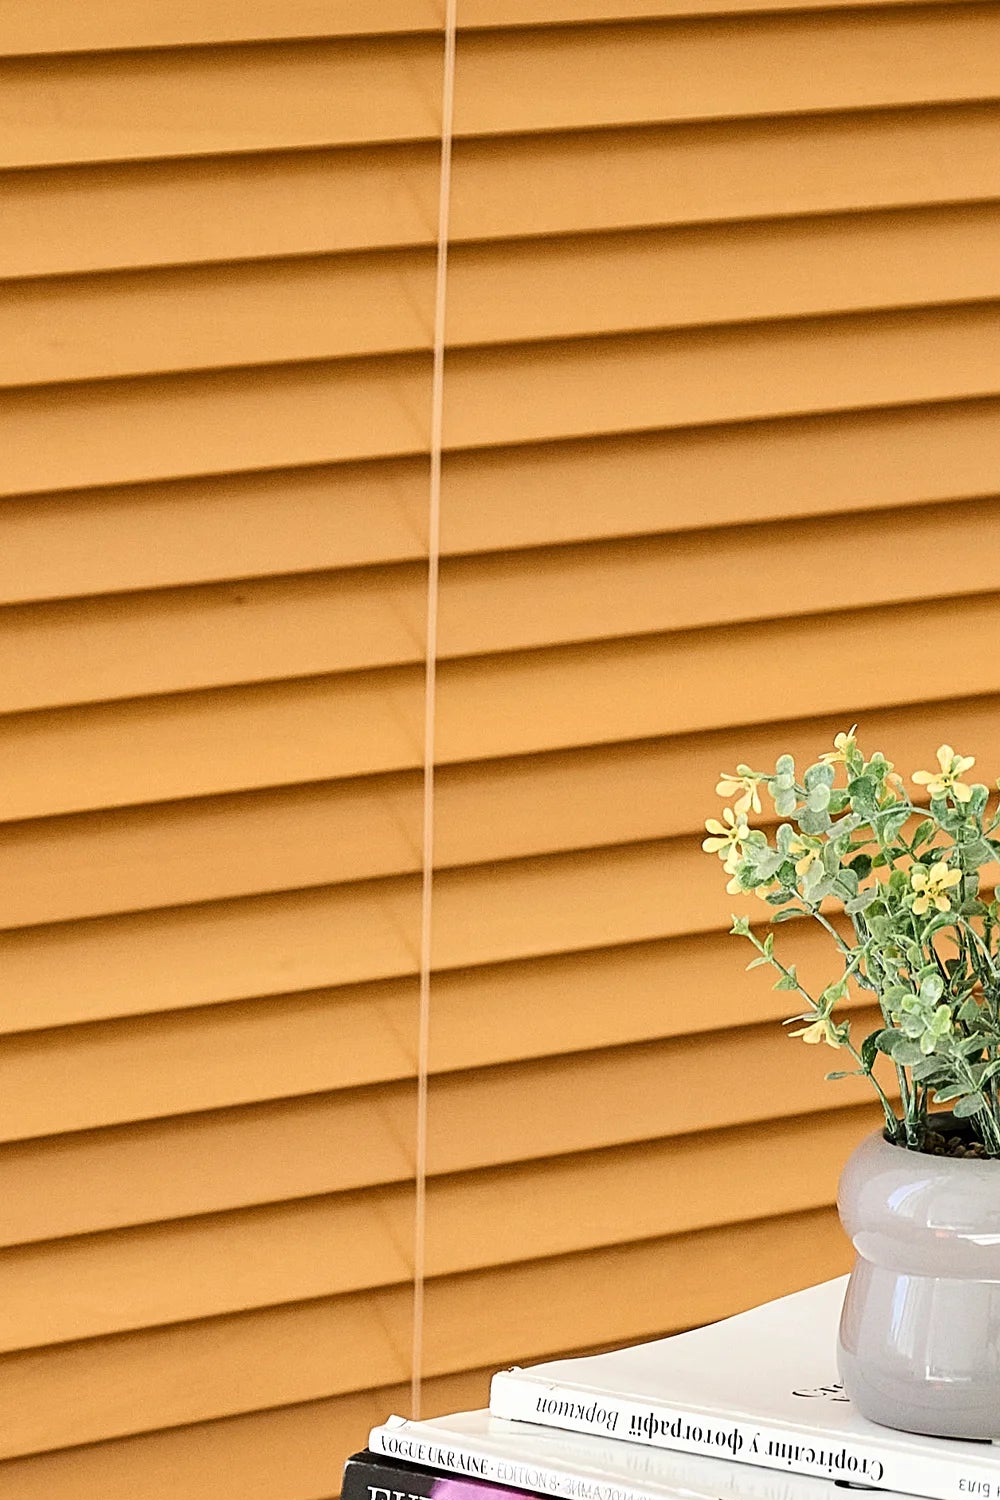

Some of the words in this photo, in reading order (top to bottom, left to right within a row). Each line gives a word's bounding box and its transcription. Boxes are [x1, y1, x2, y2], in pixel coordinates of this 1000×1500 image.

[535, 1397, 619, 1431] Воркшоп
[628, 1412, 744, 1455] фотографії
[381, 1435, 426, 1461] VOGUE
[428, 1446, 489, 1475] UKRAINE
[497, 1462, 547, 1489] EDITION
[749, 1432, 761, 1453] у
[766, 1440, 884, 1481] Сторітелінг
